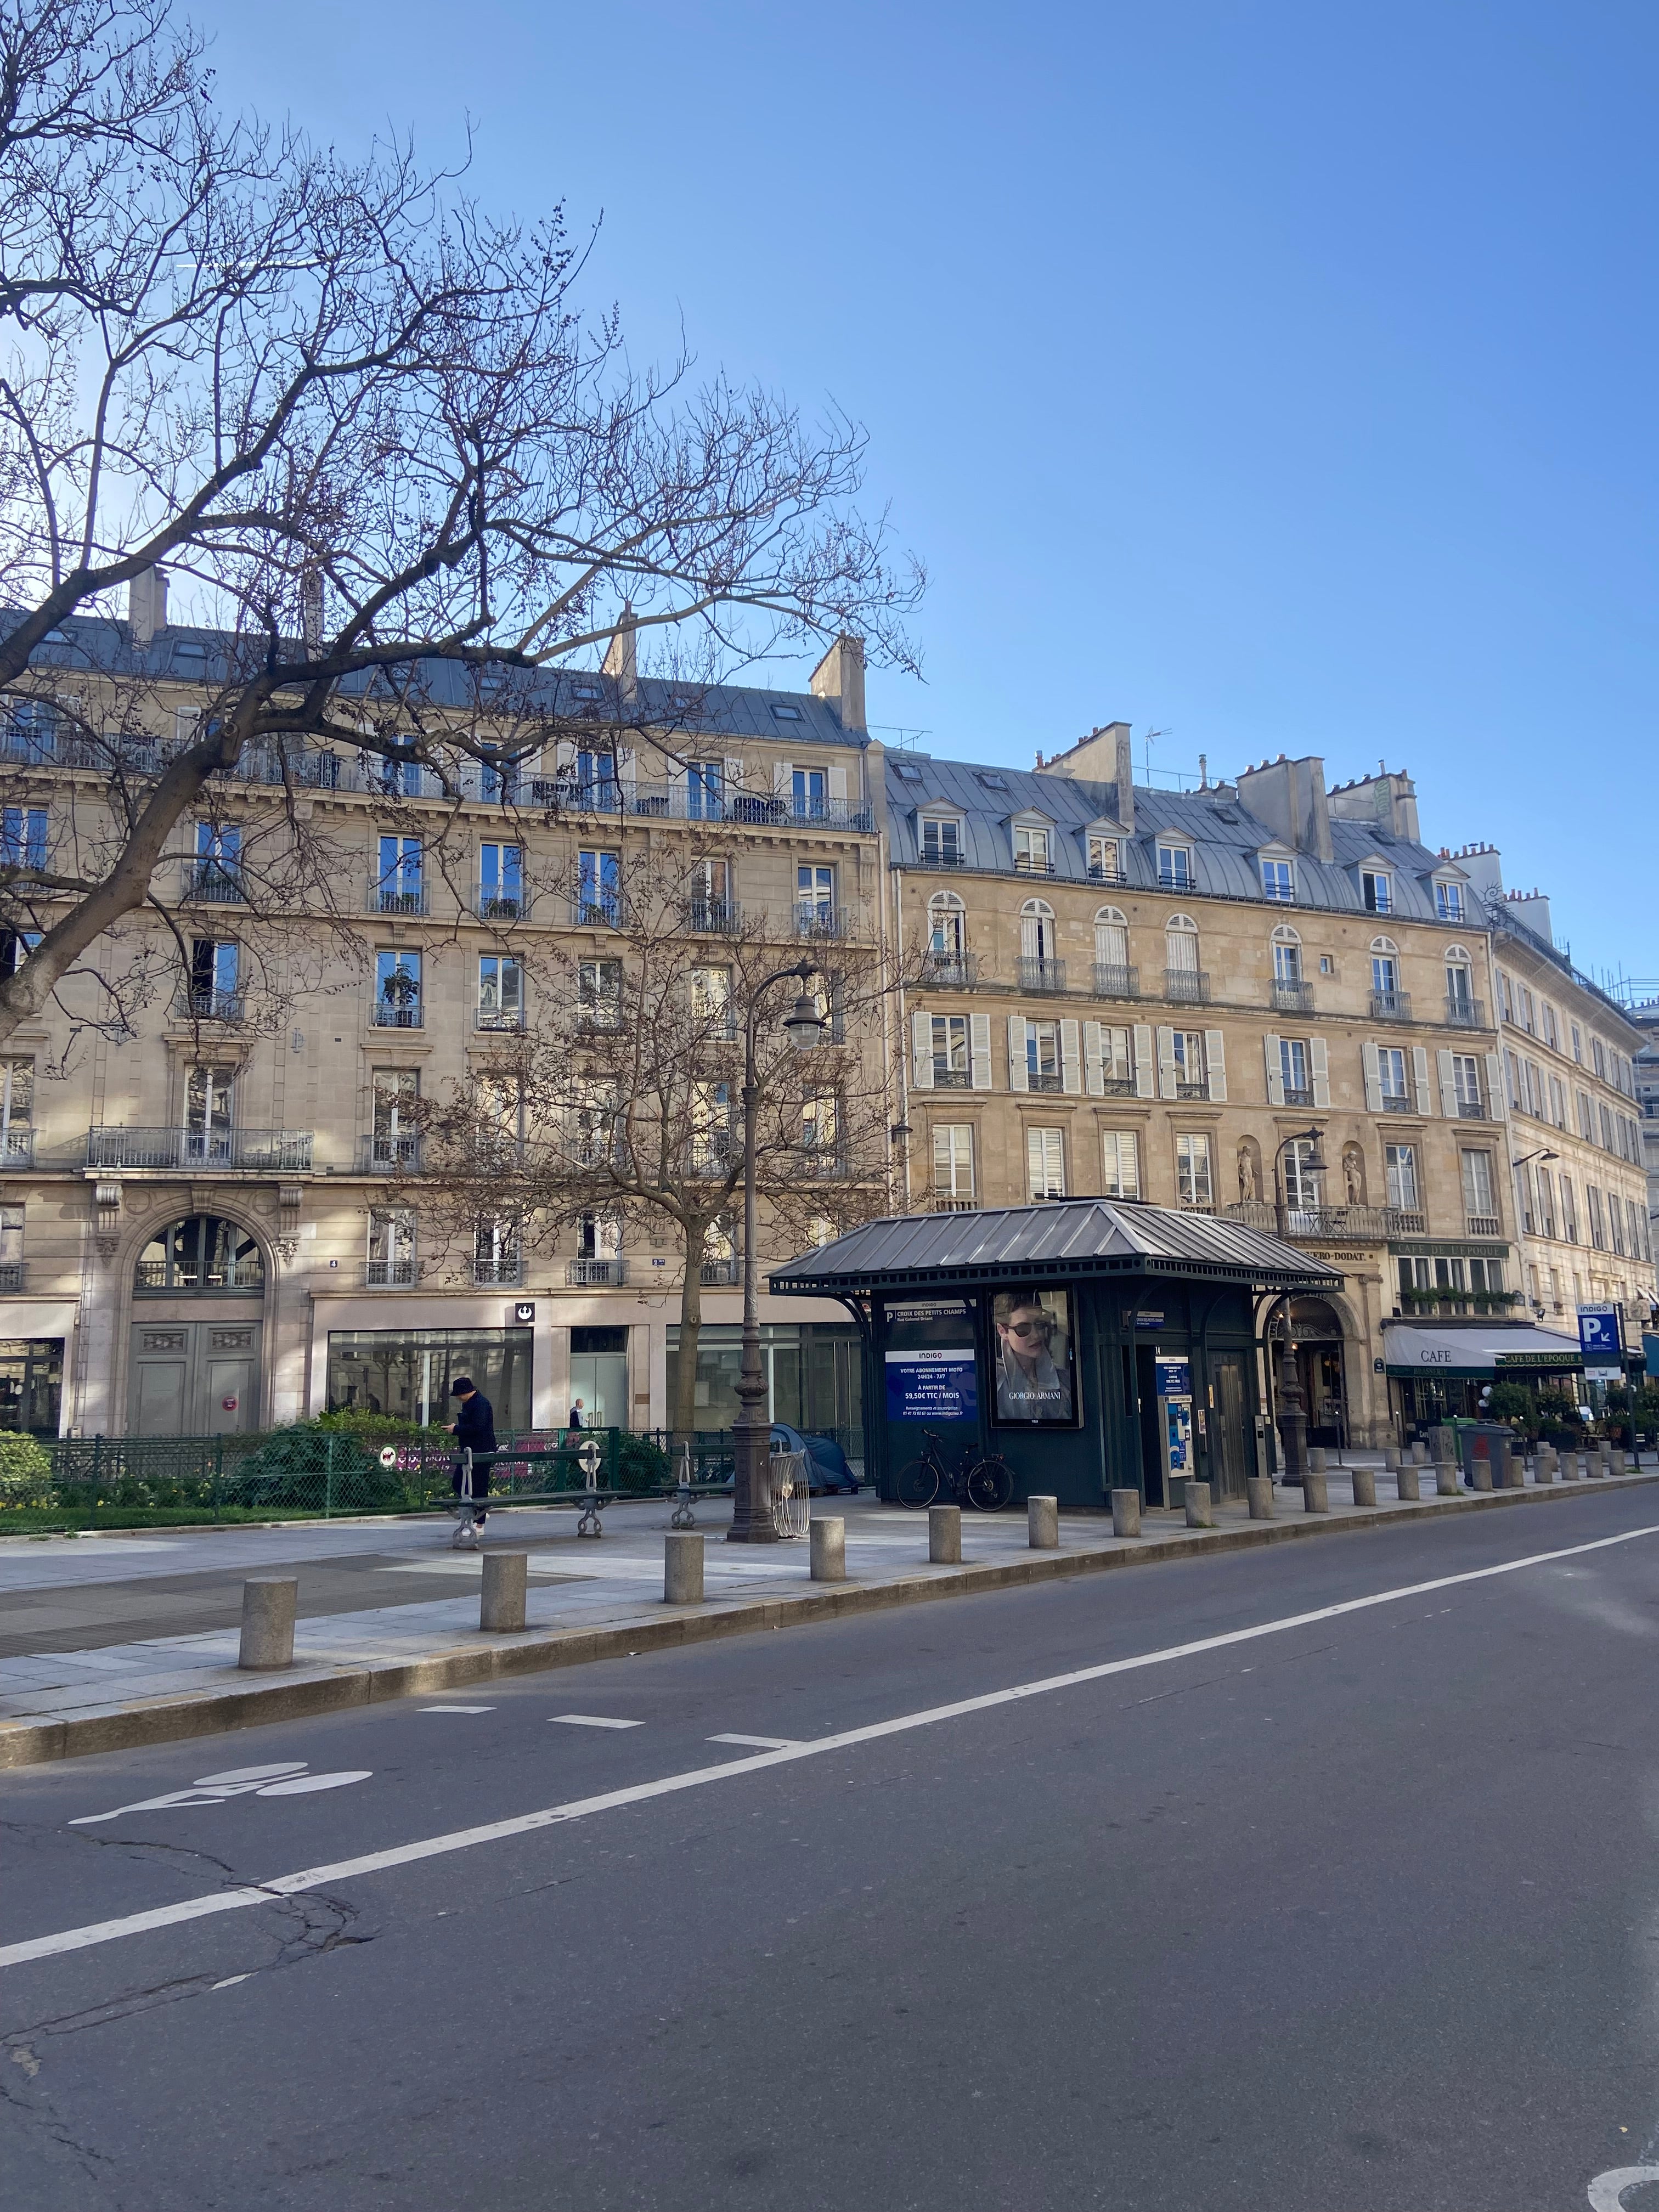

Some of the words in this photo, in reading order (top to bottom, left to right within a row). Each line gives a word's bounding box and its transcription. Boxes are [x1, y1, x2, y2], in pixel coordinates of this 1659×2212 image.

[1398, 1243, 1425, 1254] CAFE
[1431, 1244, 1445, 1255] DE
[887, 1312, 893, 1322] P
[1582, 1317, 1601, 1342] P
[1420, 1350, 1452, 1363] CAFE
[1504, 1355, 1525, 1363] CAFE
[1525, 1355, 1536, 1363] DE
[1537, 1353, 1575, 1363] L'EPOQUE
[1008, 1392, 1035, 1400] GIORGIO
[1037, 1391, 1060, 1400] ARMANI
